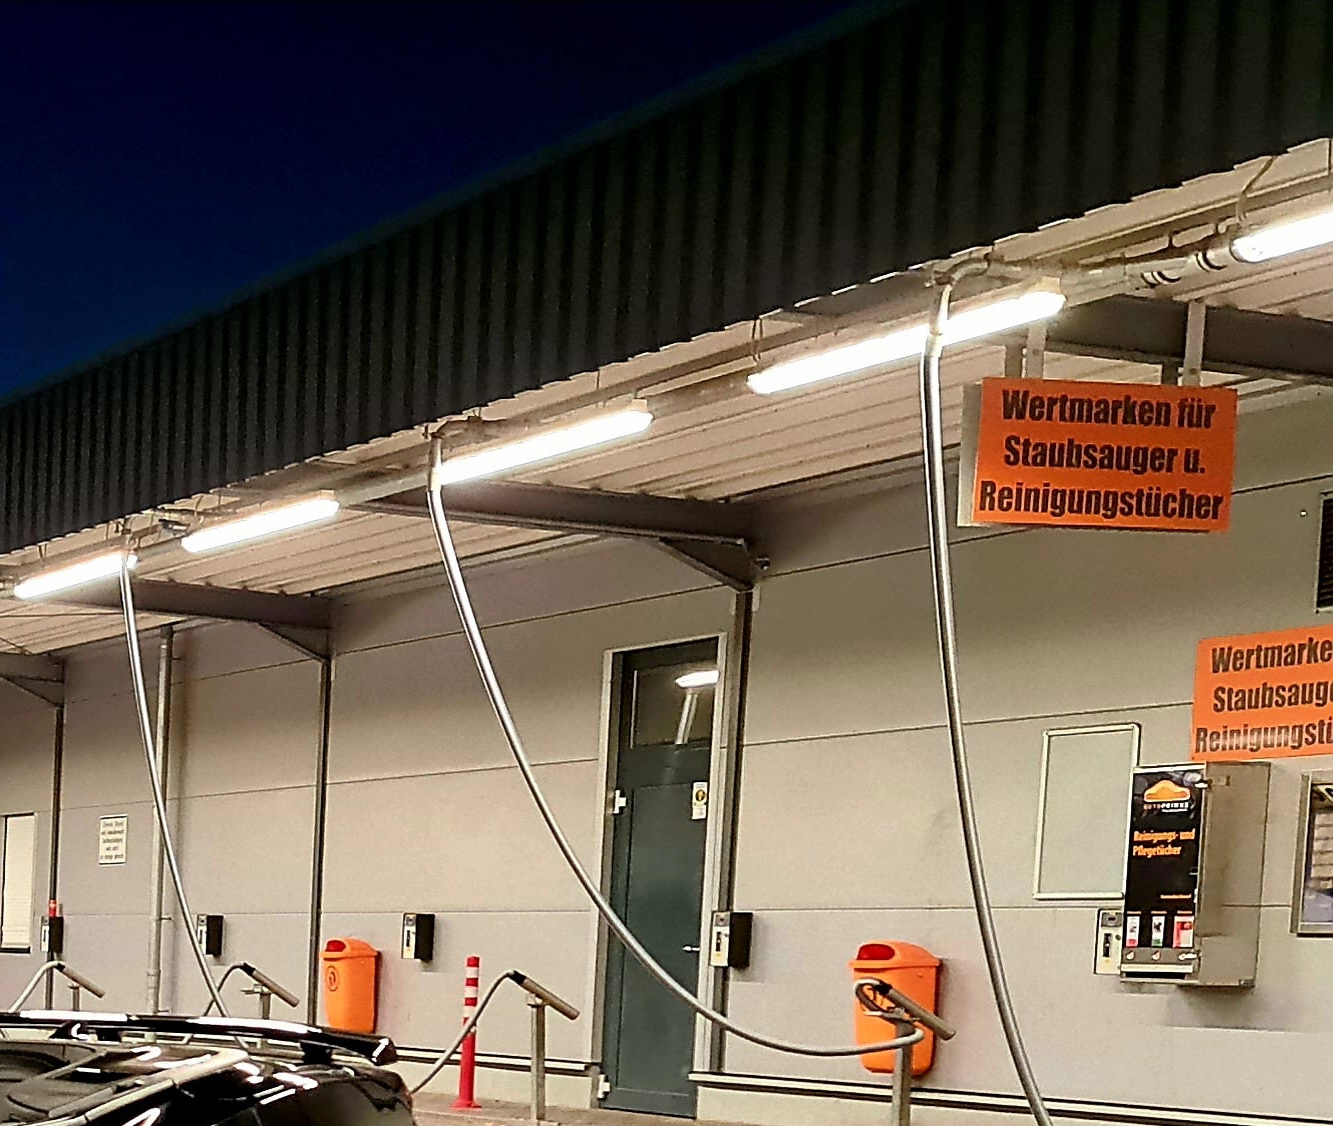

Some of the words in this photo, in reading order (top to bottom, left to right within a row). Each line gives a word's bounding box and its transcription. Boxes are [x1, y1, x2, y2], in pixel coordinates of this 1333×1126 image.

[1002, 389, 1172, 427] Wertmarken
[1177, 397, 1217, 430] für
[1004, 435, 1180, 475] Staubsauger
[1183, 447, 1206, 474] u.
[979, 480, 1225, 520] Reinigungstücher
[1213, 681, 1333, 713] Staubsaug
